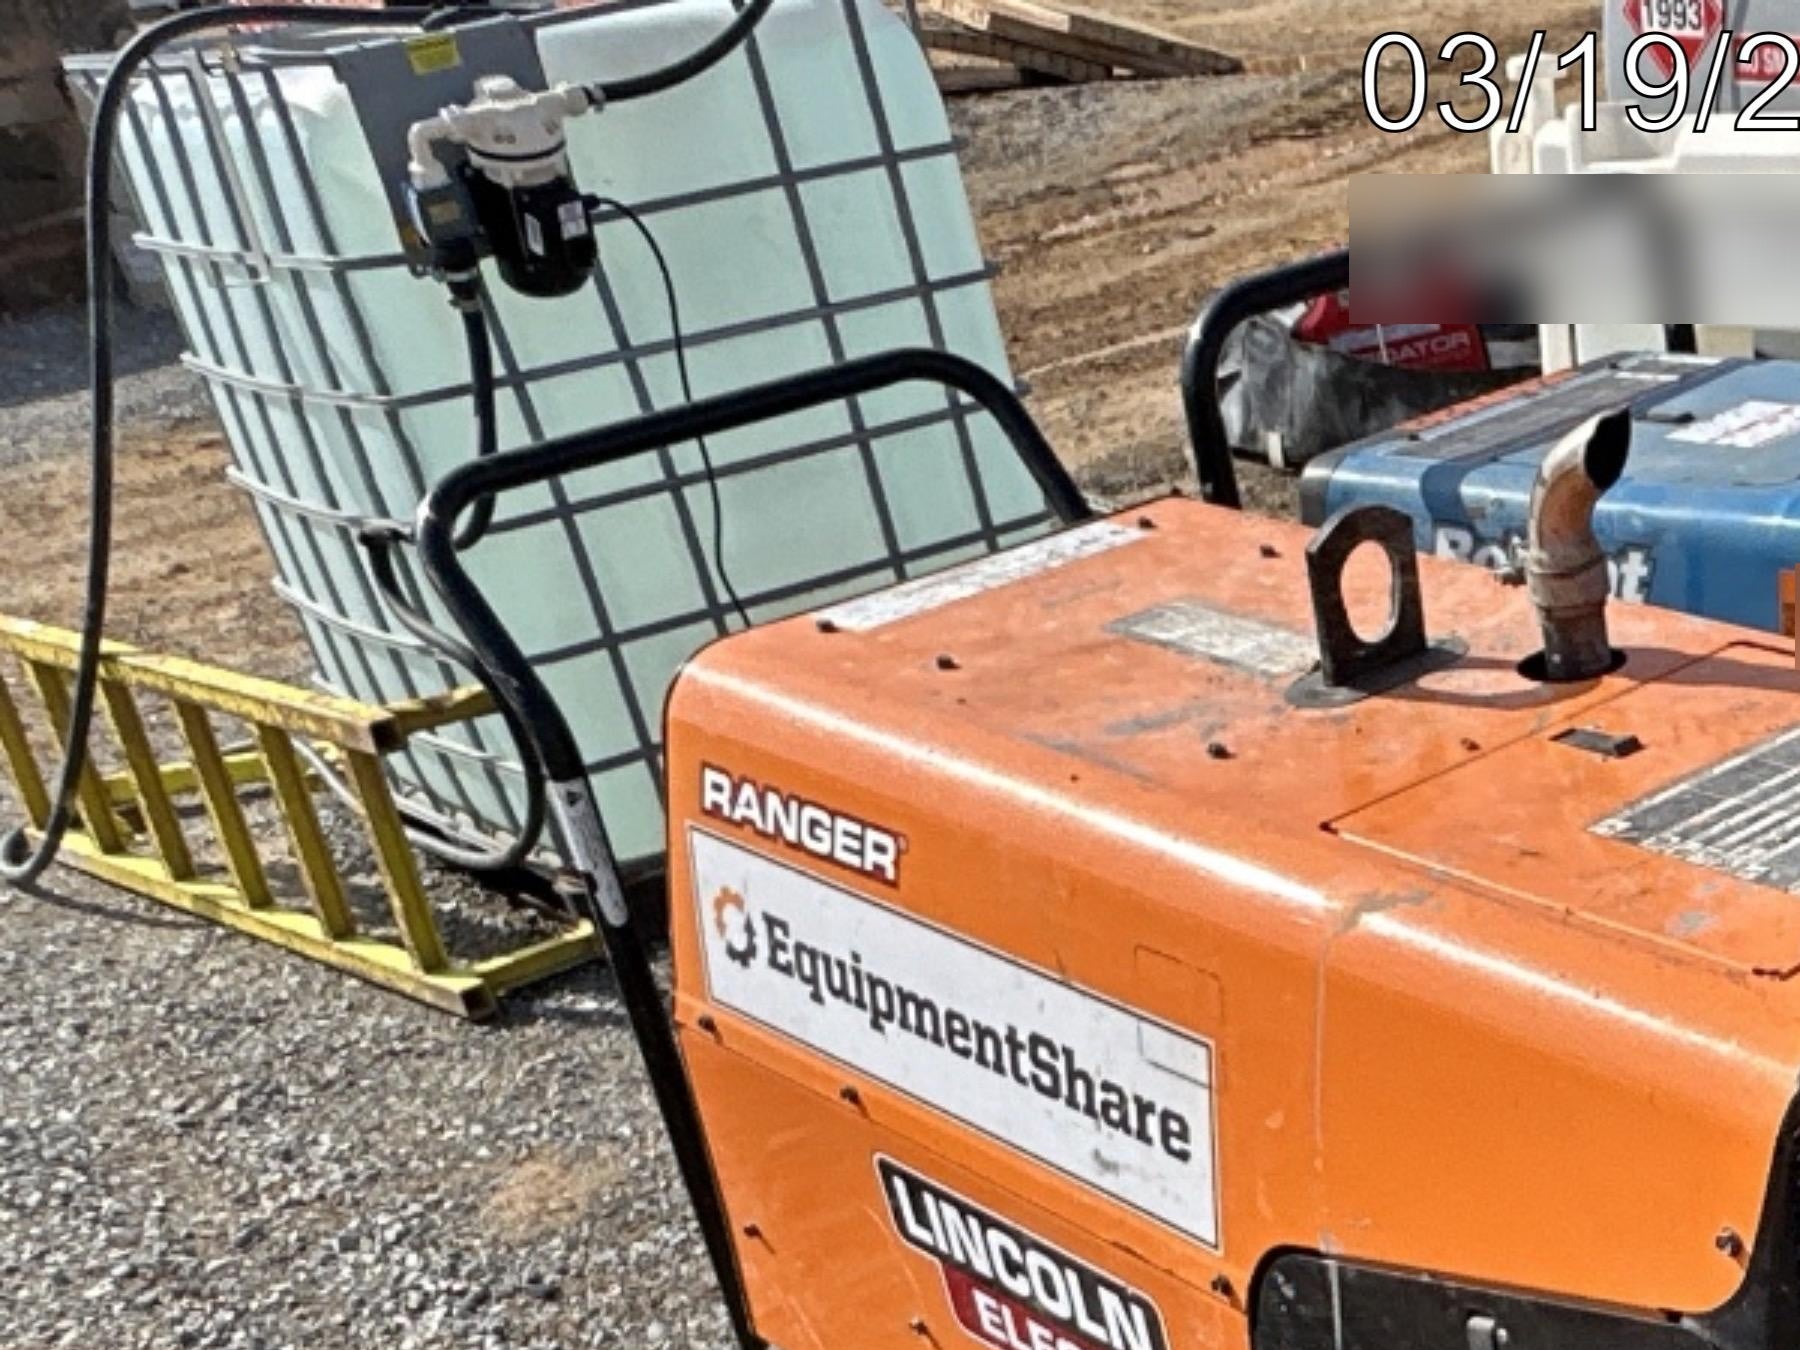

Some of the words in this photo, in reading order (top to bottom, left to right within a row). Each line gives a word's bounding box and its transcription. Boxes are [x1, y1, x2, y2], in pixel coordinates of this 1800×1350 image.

[1643, 0, 1702, 30] 1993
[703, 767, 898, 881] RANGER
[761, 911, 1192, 1162] EquipmentShare
